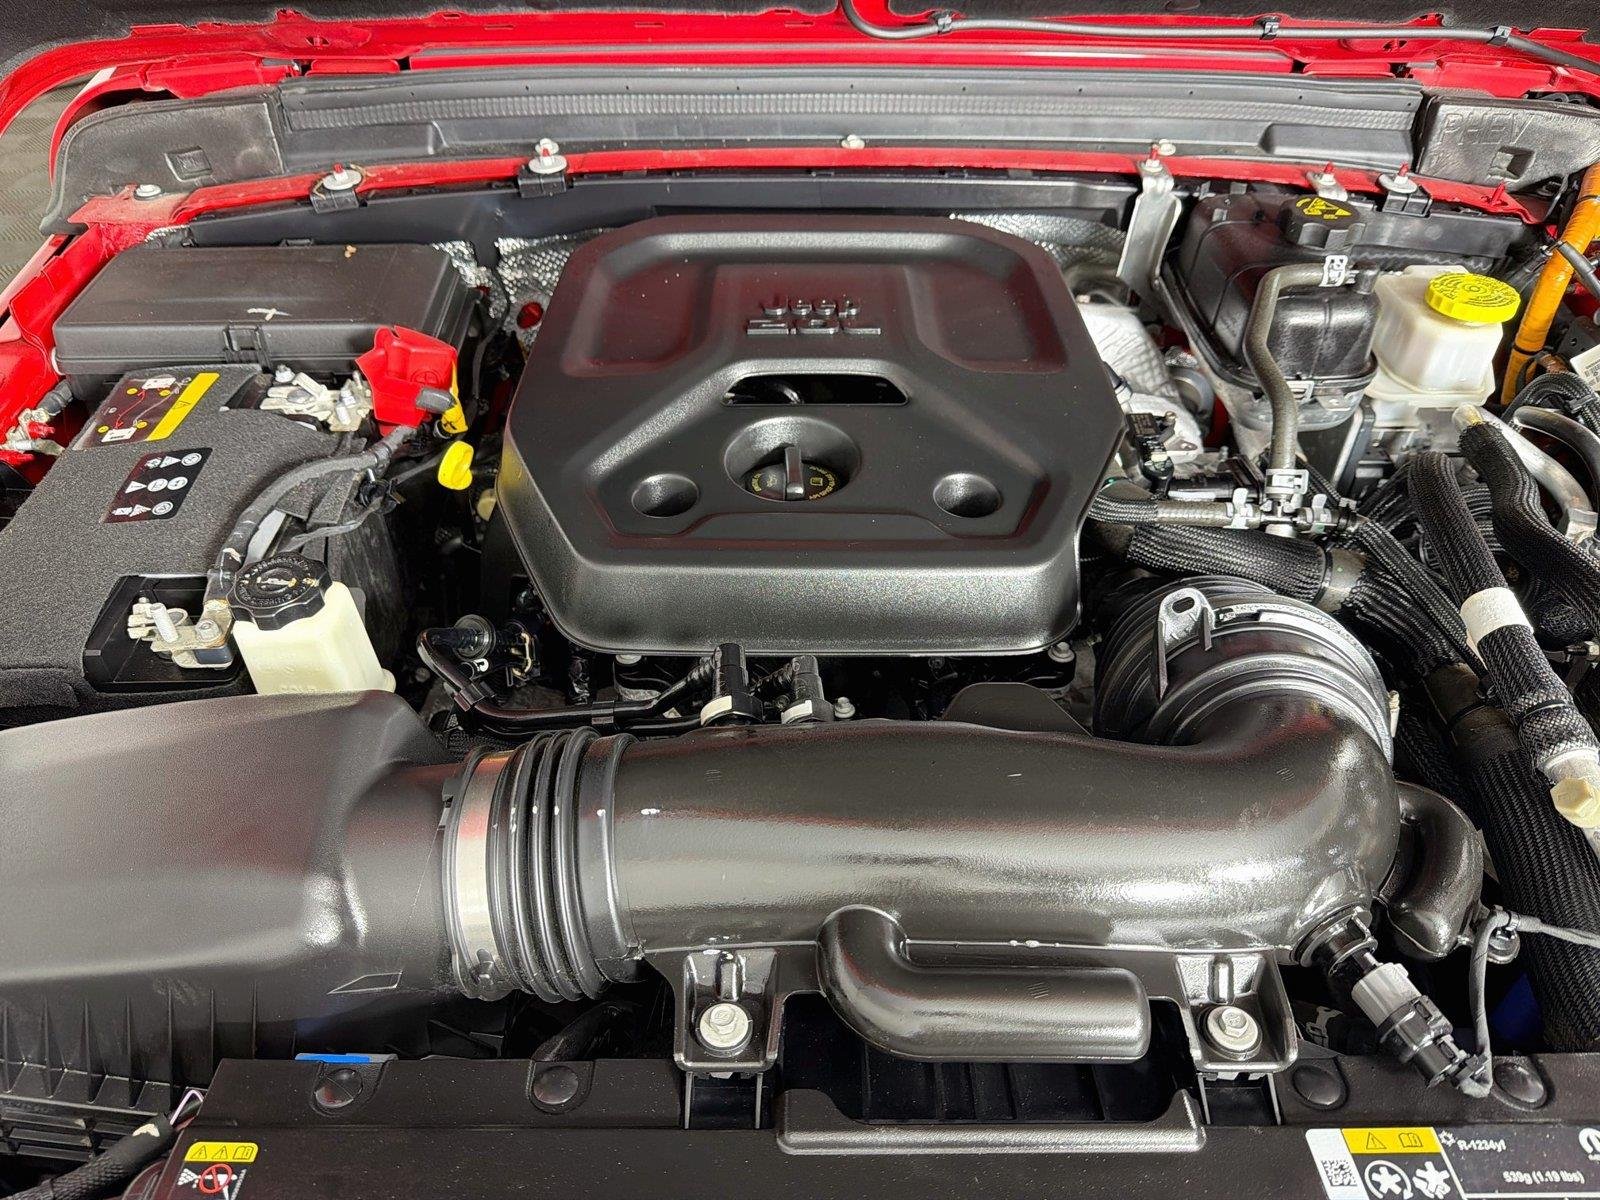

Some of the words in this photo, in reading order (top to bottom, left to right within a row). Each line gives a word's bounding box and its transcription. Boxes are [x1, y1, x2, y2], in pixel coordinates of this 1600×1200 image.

[1436, 112, 1536, 146] PHEV
[1502, 1170, 1533, 1185] 539g
[1532, 1170, 1560, 1184] (1.19
[1560, 1170, 1585, 1184] lbs)
